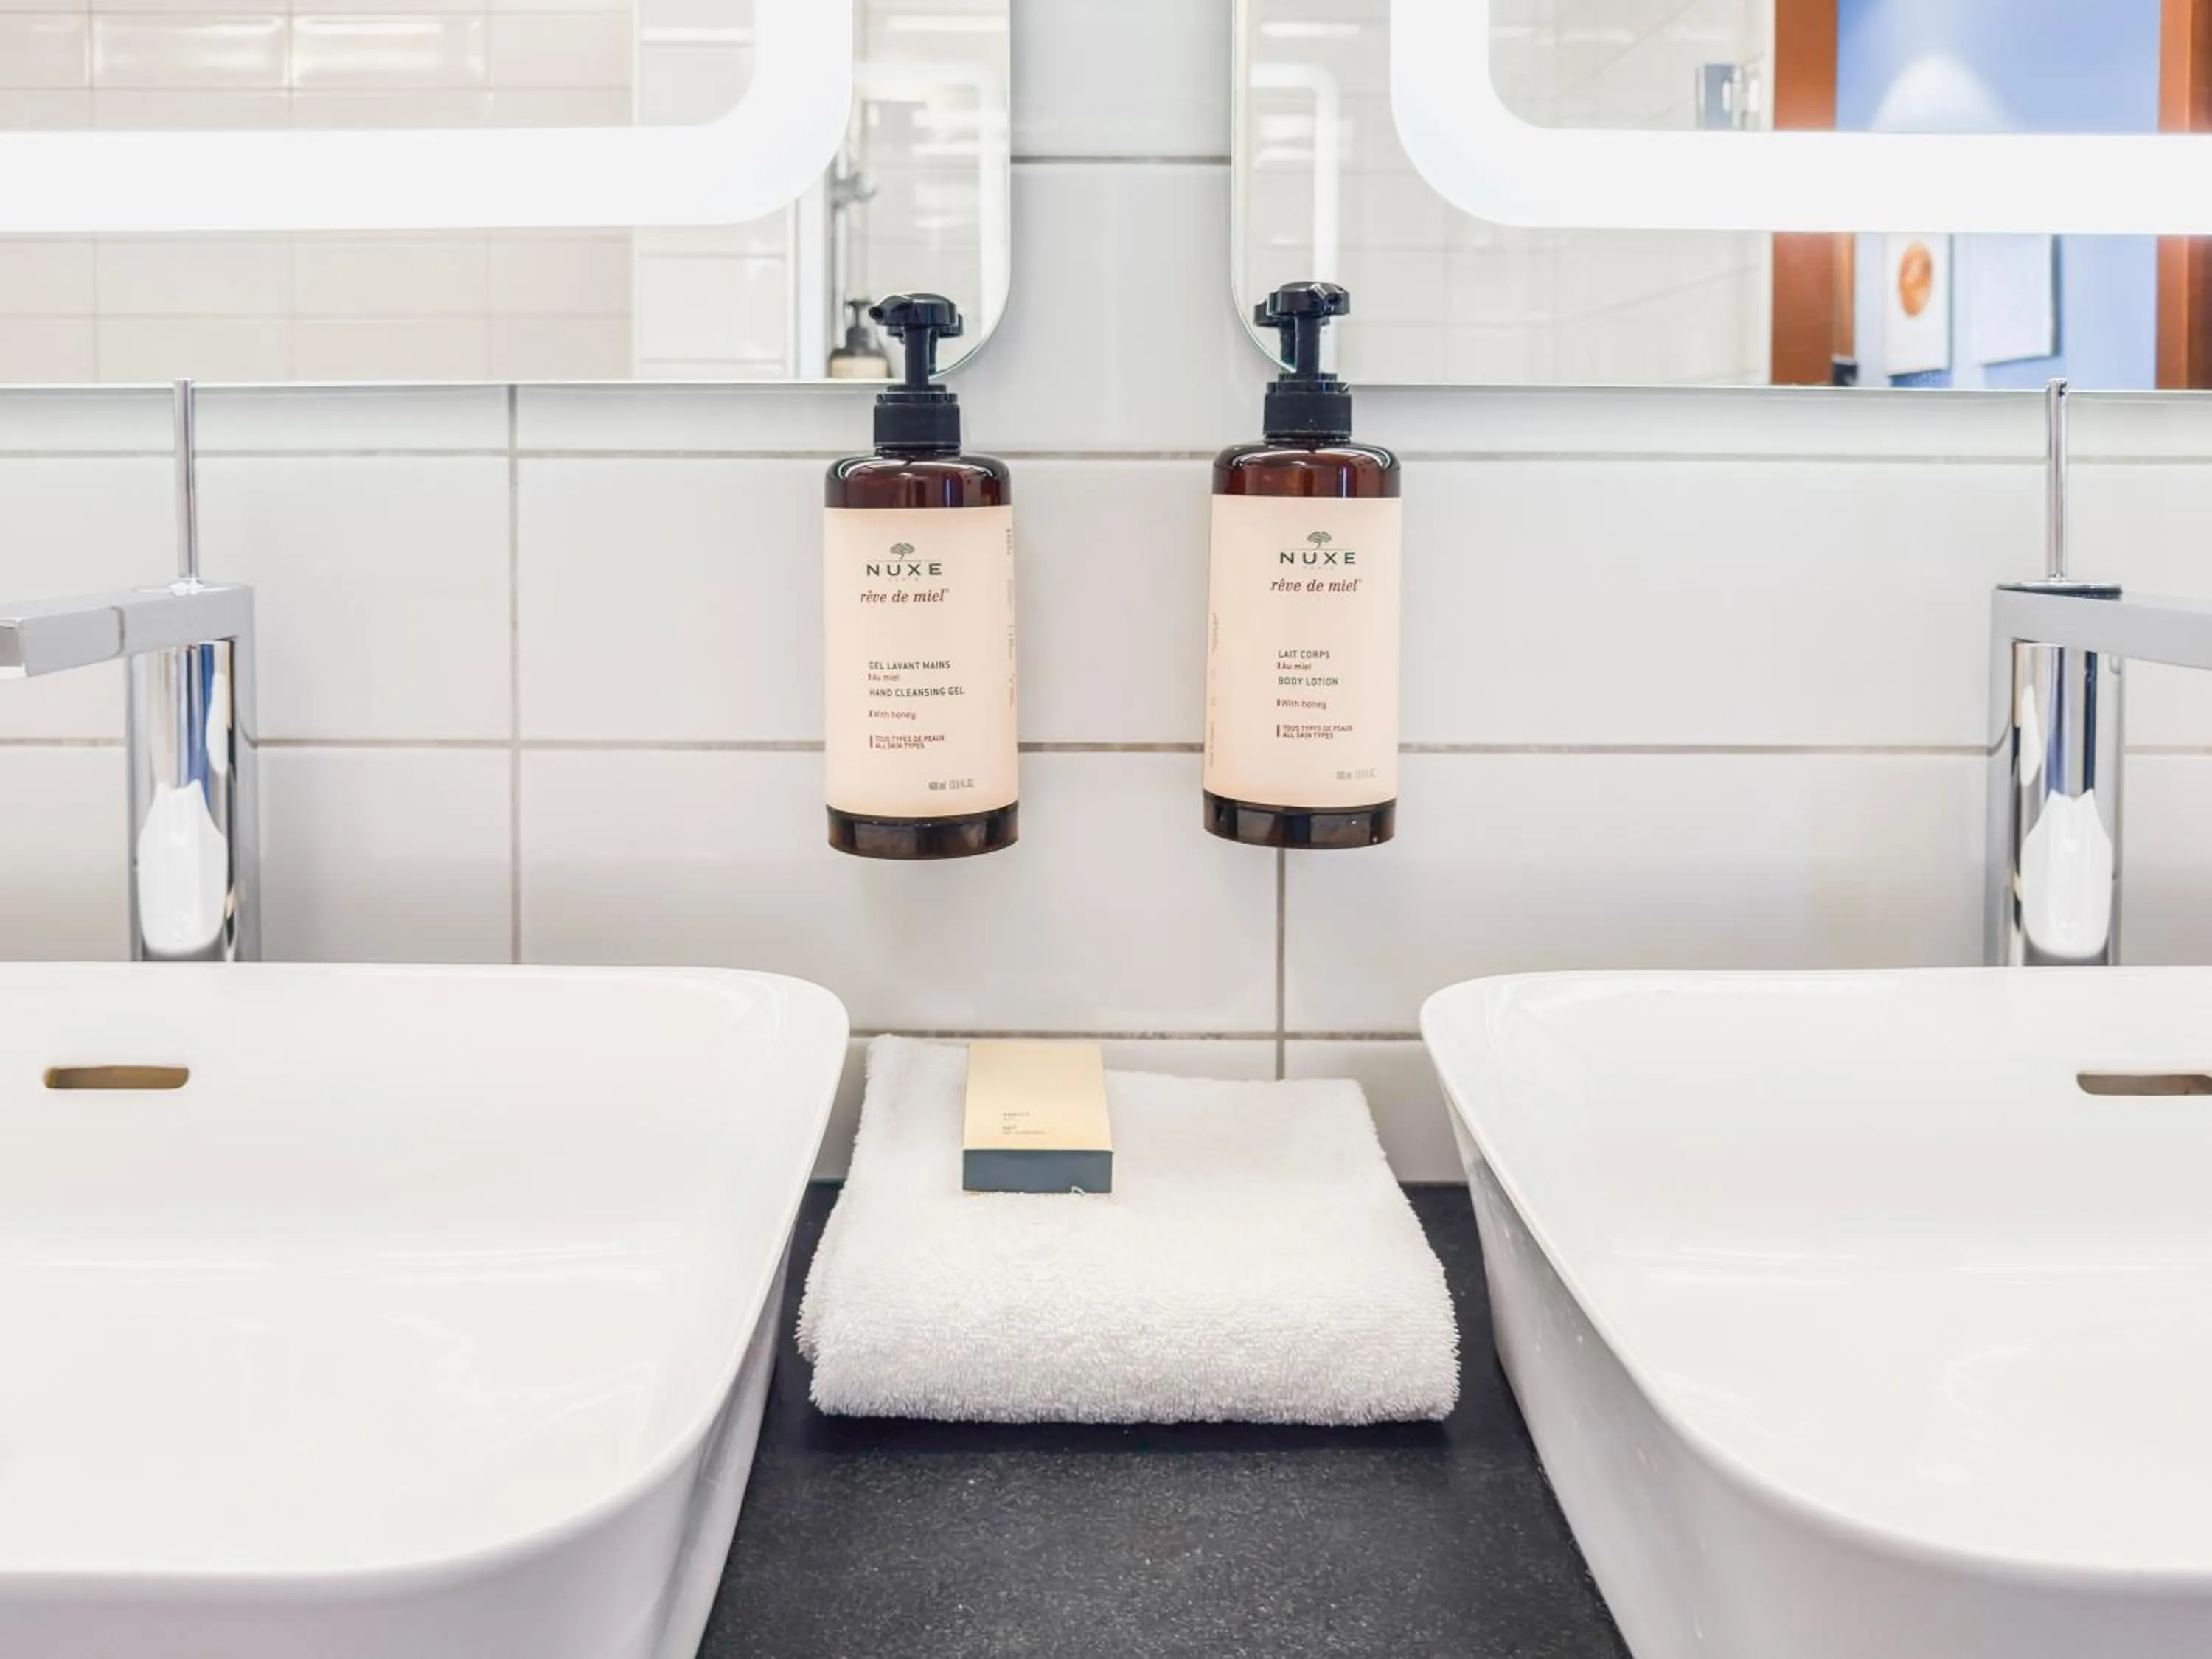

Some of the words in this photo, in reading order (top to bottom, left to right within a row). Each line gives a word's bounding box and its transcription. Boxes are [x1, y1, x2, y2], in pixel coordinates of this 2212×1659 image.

[1279, 552, 1357, 564] NUXE
[866, 563, 943, 577] NUXE
[1270, 579, 1301, 591] rêve
[1306, 579, 1324, 592] de
[1328, 579, 1358, 592] miel
[860, 590, 887, 603] rêve
[891, 589, 909, 602] de
[913, 589, 945, 602] miel
[1278, 650, 1298, 658] LAIT
[1300, 650, 1330, 659] CORPS
[869, 661, 885, 670] GEL
[887, 661, 919, 670] LAVANT
[922, 661, 951, 669] MAINS
[1281, 662, 1292, 670] Au
[1278, 677, 1304, 686] BODY
[1305, 678, 1338, 686] LOTION
[869, 689, 893, 698] HAND
[895, 687, 946, 697] CLEANSING
[948, 686, 965, 695] GEL
[1281, 700, 1300, 708] With
[1301, 700, 1326, 710] honey
[891, 710, 917, 720] honey
